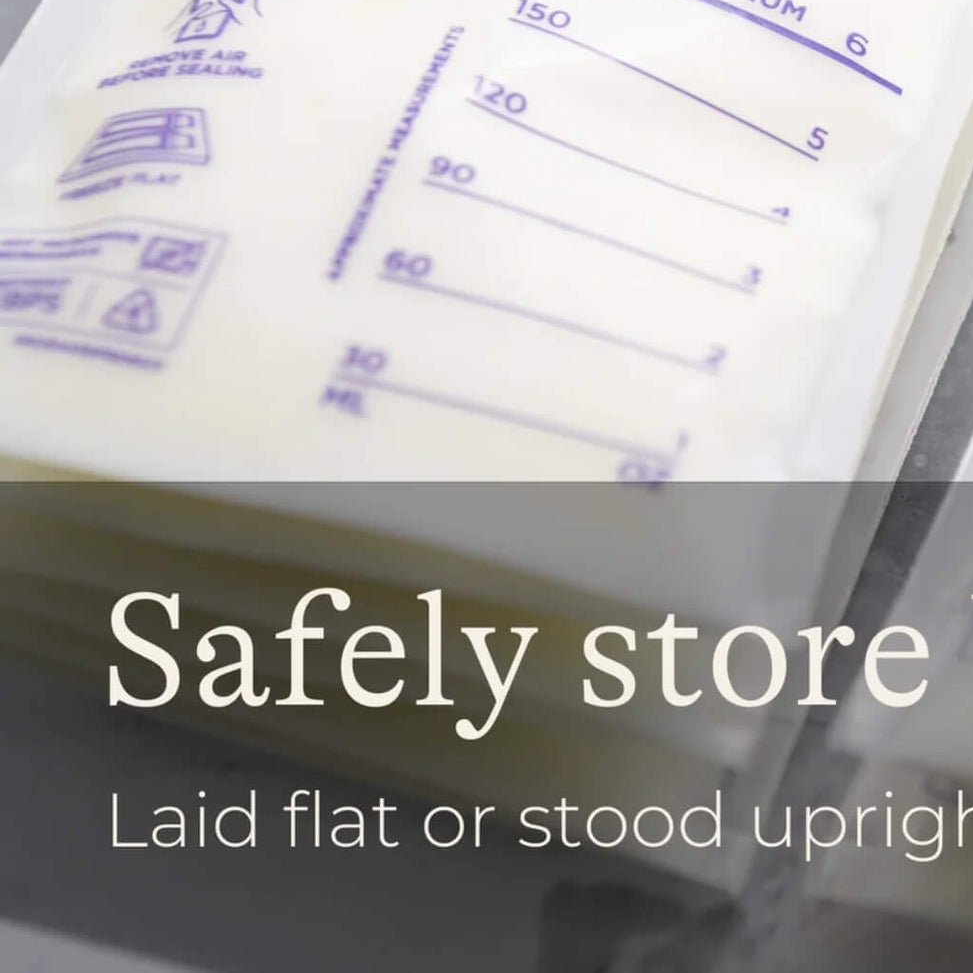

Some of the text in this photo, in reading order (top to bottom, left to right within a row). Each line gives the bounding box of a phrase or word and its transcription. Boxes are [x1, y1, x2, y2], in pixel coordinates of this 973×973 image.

[844, 31, 870, 58] 6
[175, 63, 264, 80] SEALING
[385, 24, 466, 152] MEASUREMENTS
[470, 73, 528, 116] 120
[806, 126, 829, 152] 5
[427, 154, 477, 186] 90
[381, 249, 435, 279] 60
